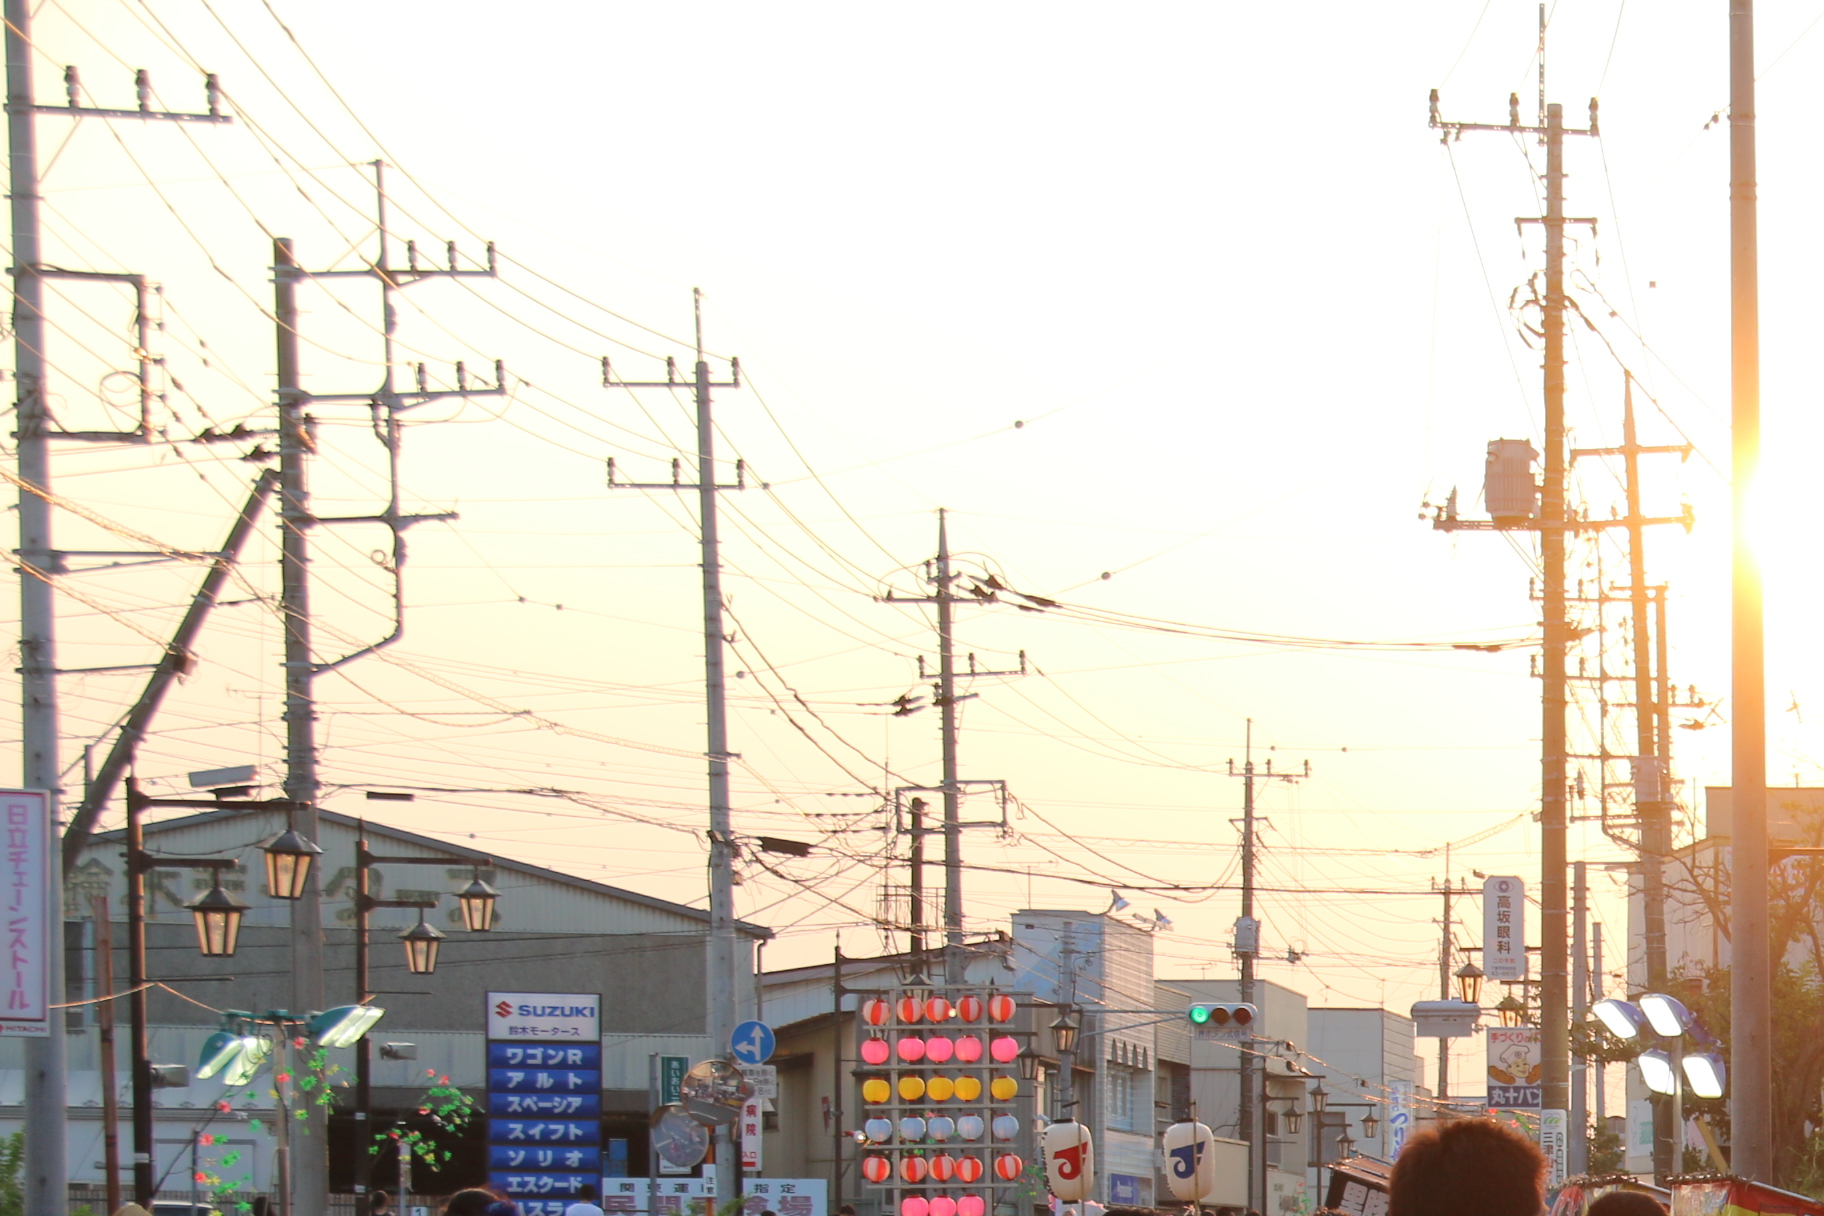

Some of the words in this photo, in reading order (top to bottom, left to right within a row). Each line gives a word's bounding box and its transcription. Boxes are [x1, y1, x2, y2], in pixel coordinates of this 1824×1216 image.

[1496, 895, 1511, 955] 高坂眼科
[518, 1004, 596, 1018] SUZUKI
[5, 1025, 47, 1033] HITACHI
[508, 1025, 581, 1037] 鈴木モータース
[506, 1047, 583, 1065] ワゴンR
[506, 1072, 583, 1089] アルト
[507, 1096, 583, 1114] スペーシア
[746, 1104, 757, 1137] 病院
[507, 1123, 584, 1140] スイフト
[507, 1149, 584, 1168] ソリオ
[507, 1176, 583, 1194] エスクード
